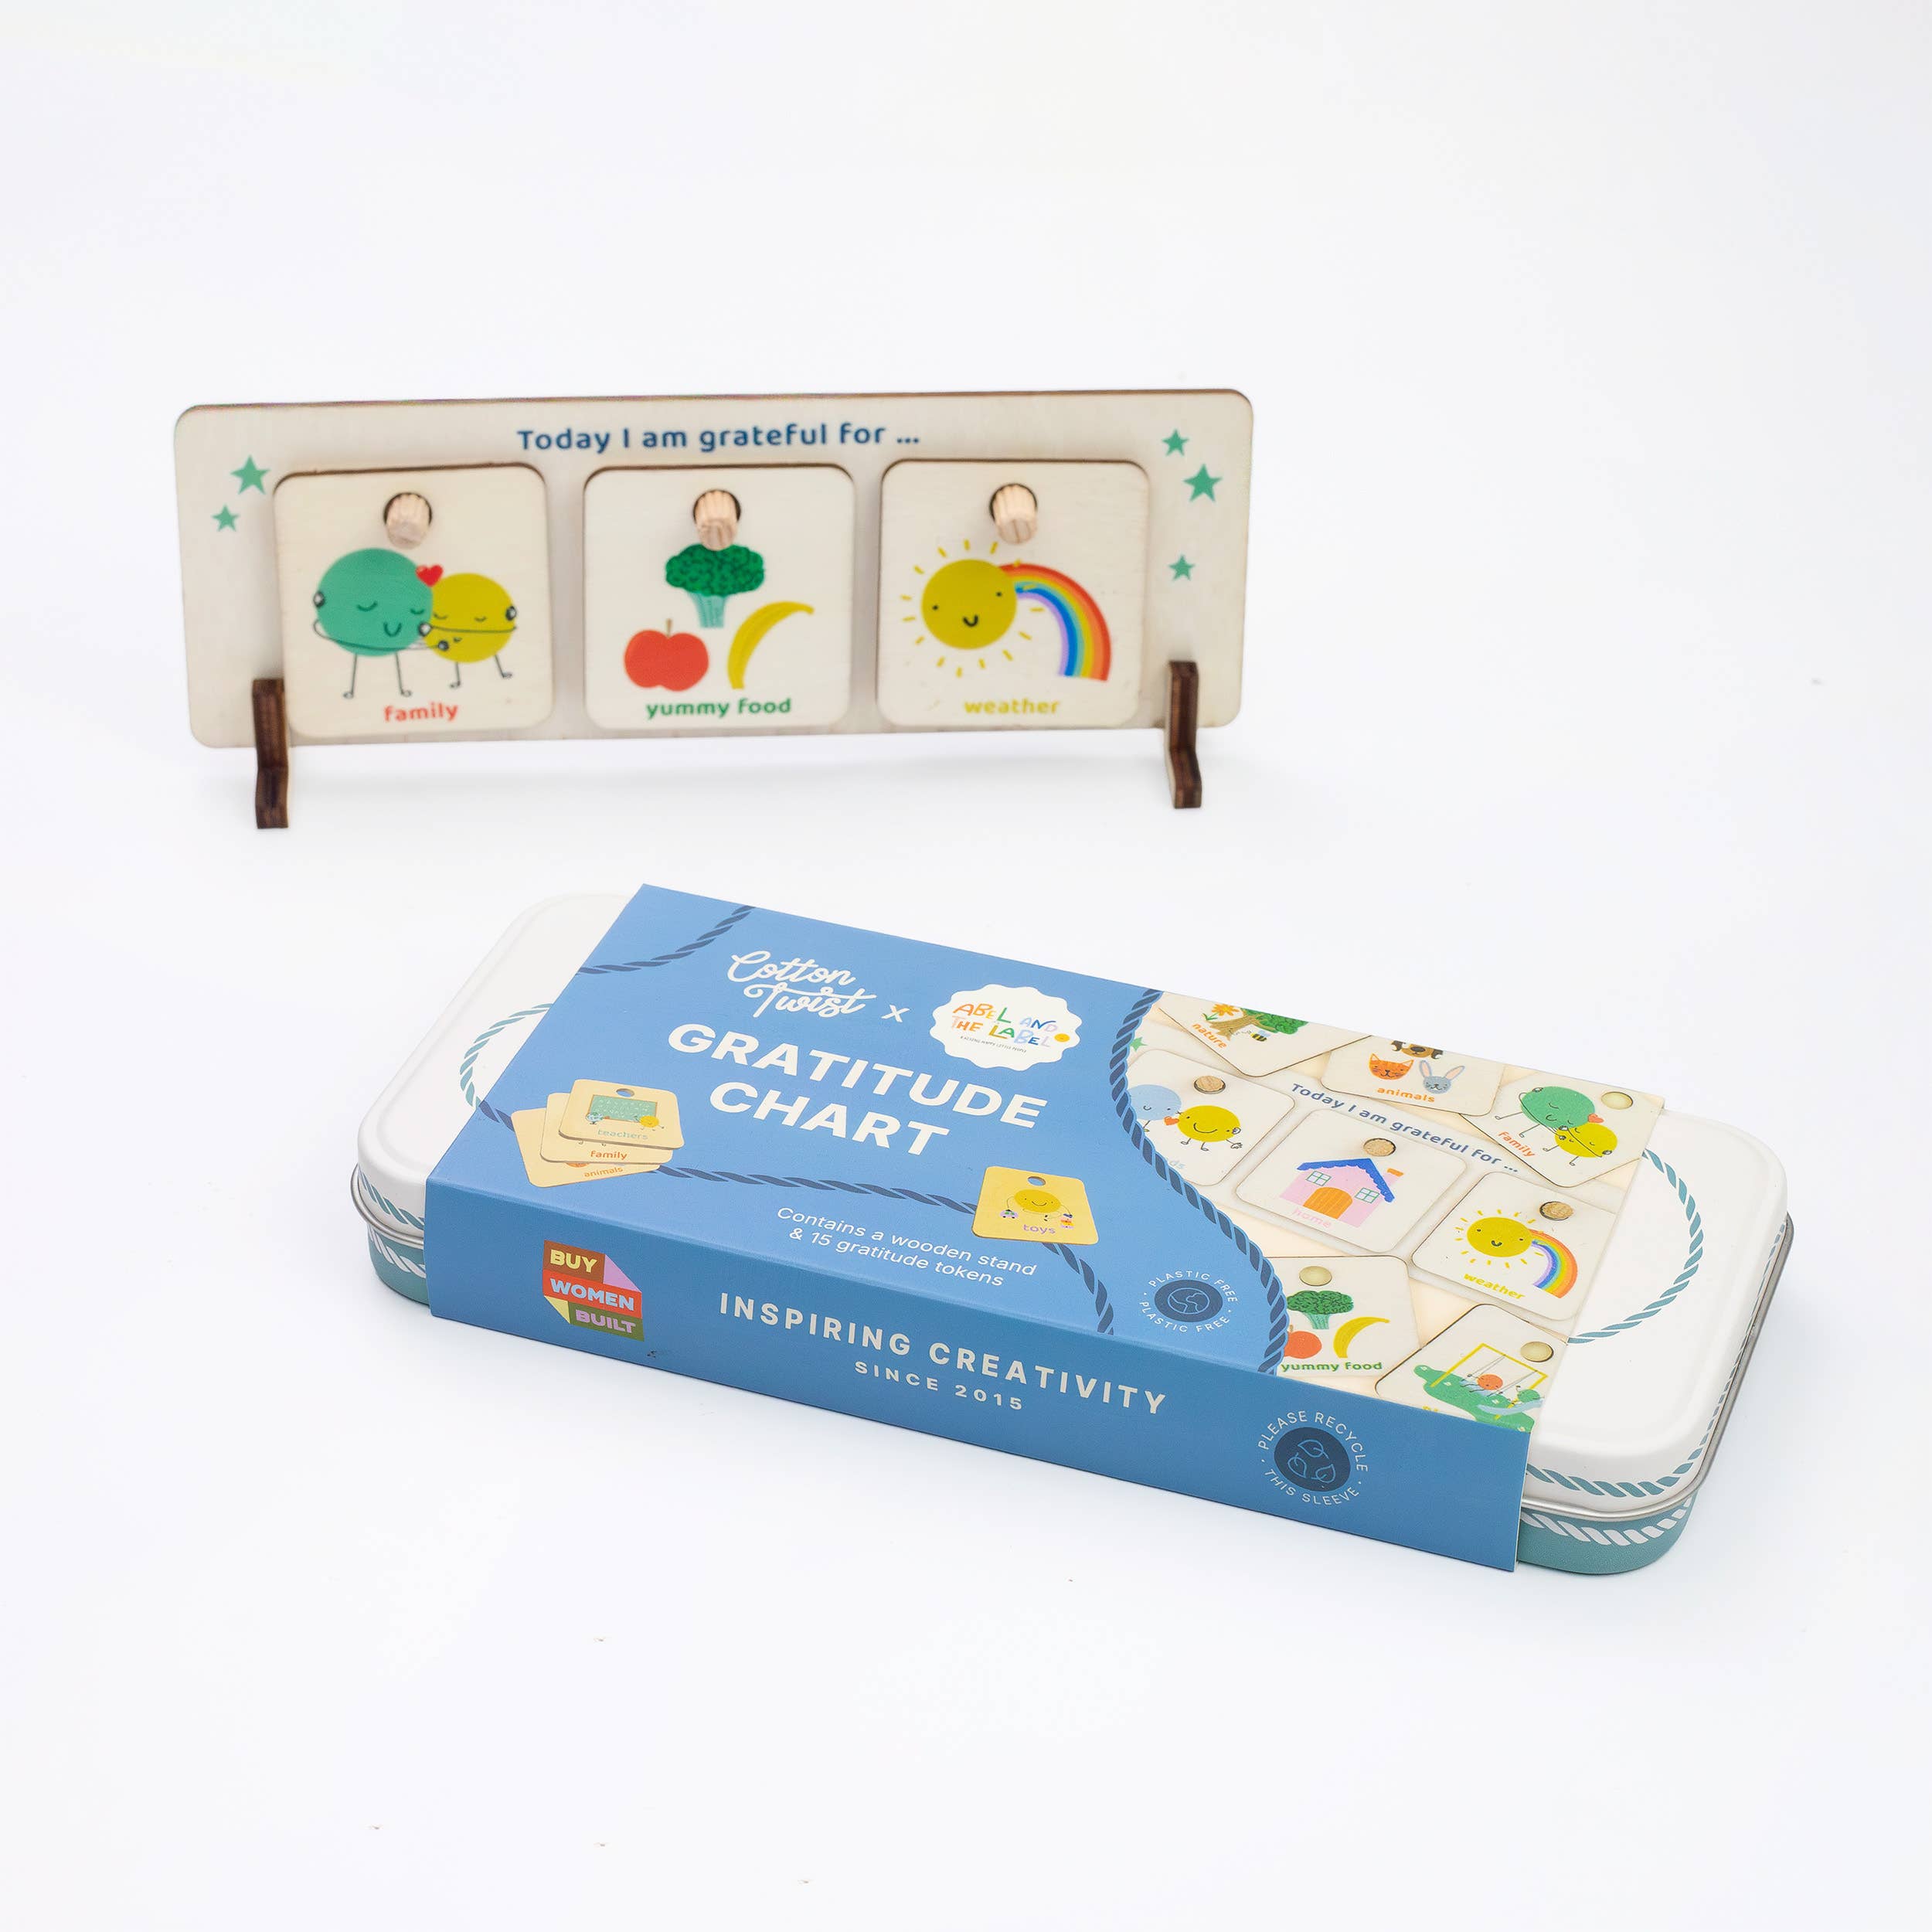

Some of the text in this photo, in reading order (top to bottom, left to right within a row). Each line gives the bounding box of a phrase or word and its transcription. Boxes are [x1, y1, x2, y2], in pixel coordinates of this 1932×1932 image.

[517, 427, 611, 454] Today
[624, 428, 629, 447] I
[642, 430, 687, 448] am
[699, 423, 827, 452] grateful
[840, 423, 885, 444] for
[384, 702, 458, 722] family
[646, 698, 791, 719] yummy food
[965, 698, 1060, 714] weather
[727, 951, 855, 985] Cotton
[743, 982, 877, 1018] Twist
[952, 1015, 1051, 1047] THE LABEL
[1019, 1017, 1059, 1032] AND
[1192, 1023, 1227, 1049] nature
[668, 1024, 1048, 1128] GRATITUDE
[1377, 1087, 1435, 1103] animals
[709, 1082, 950, 1156] CHART
[1292, 1083, 1344, 1109] Today
[1359, 1109, 1387, 1124] am
[1389, 1122, 1469, 1154] grateful
[1471, 1149, 1502, 1164] for
[597, 1128, 648, 1140] teachers
[1498, 1131, 1536, 1157] family
[590, 1150, 628, 1160] family
[583, 1166, 624, 1177] animals
[1023, 1224, 1056, 1235] toys
[1291, 1208, 1333, 1229] home
[777, 1207, 1037, 1277] Contains a wooden stand
[549, 1249, 597, 1273] BUY
[789, 1227, 1005, 1287] & 15 gratitude tokens
[549, 1278, 634, 1311] WOMEN
[1148, 1270, 1237, 1302] PLASTIC FREE
[1463, 1273, 1525, 1300] weather
[575, 1309, 636, 1334] BUILT
[1139, 1301, 1230, 1332] PLASTIC FREE
[719, 1292, 1166, 1414] INSPIRING CREATIVITY
[1281, 1360, 1383, 1372] yummy food
[855, 1361, 1022, 1410] SINCE 2015
[1258, 1410, 1368, 1471] PLEASE RECYCLE
[1264, 1469, 1359, 1505] THIS SLEEVE
